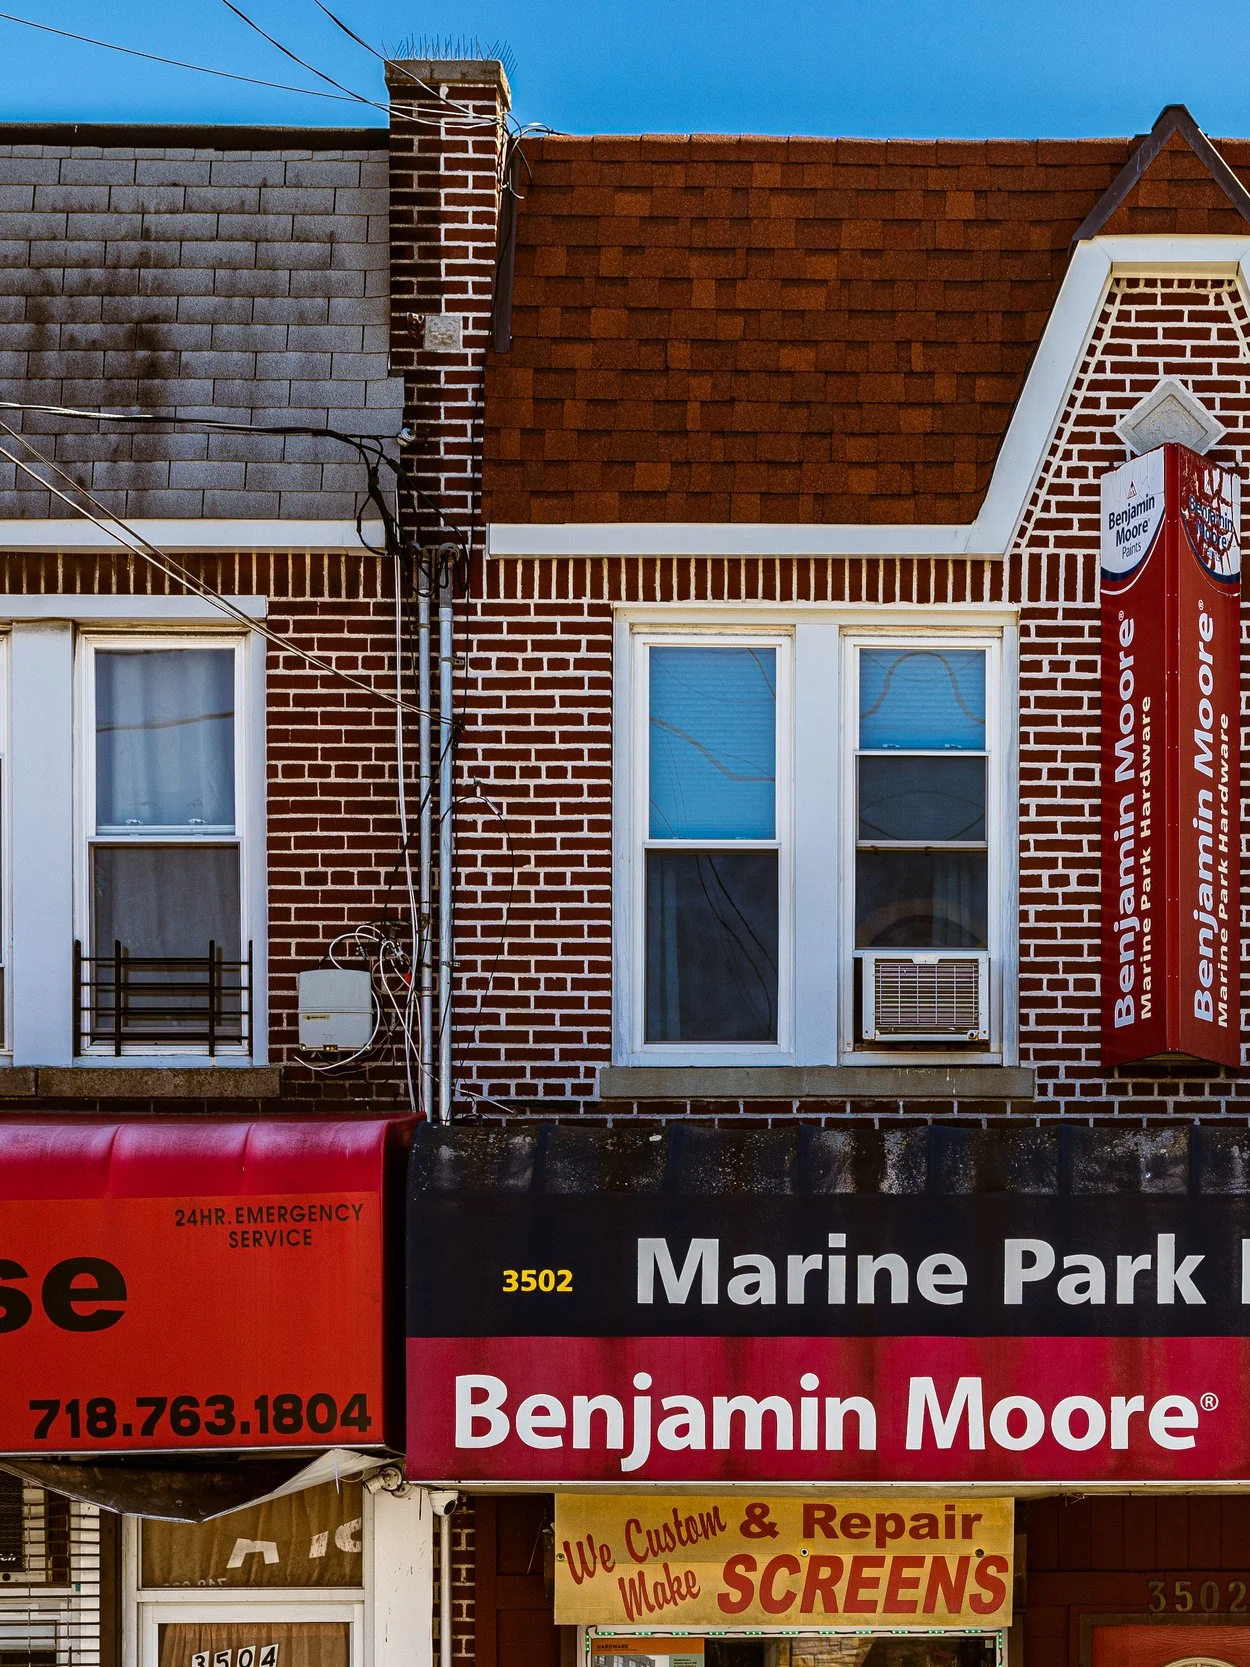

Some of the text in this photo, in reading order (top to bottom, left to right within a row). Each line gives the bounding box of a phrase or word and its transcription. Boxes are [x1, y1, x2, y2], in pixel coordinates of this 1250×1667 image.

[1108, 494, 1155, 531] Benjamin
[1122, 541, 1142, 559] Paints
[1140, 695, 1152, 1020] Marine Park Hardware
[1217, 713, 1229, 1028] Marine Park Hardware
[1114, 793, 1141, 1029] Benjamin
[1192, 789, 1219, 1022] Benjamin
[228, 1229, 313, 1249] SERVICE
[637, 1232, 968, 1306] Marine
[1004, 1233, 1207, 1306] Park
[502, 1269, 573, 1293] 3502
[29, 1393, 373, 1440] 718.763.1804
[454, 1371, 877, 1472] Benjamin
[566, 1505, 727, 1585] We Custom
[739, 1502, 983, 1548] & Repair
[617, 1561, 702, 1623] Make
[717, 1552, 1009, 1615] SCREENS
[1148, 1580, 1248, 1613] 3502
